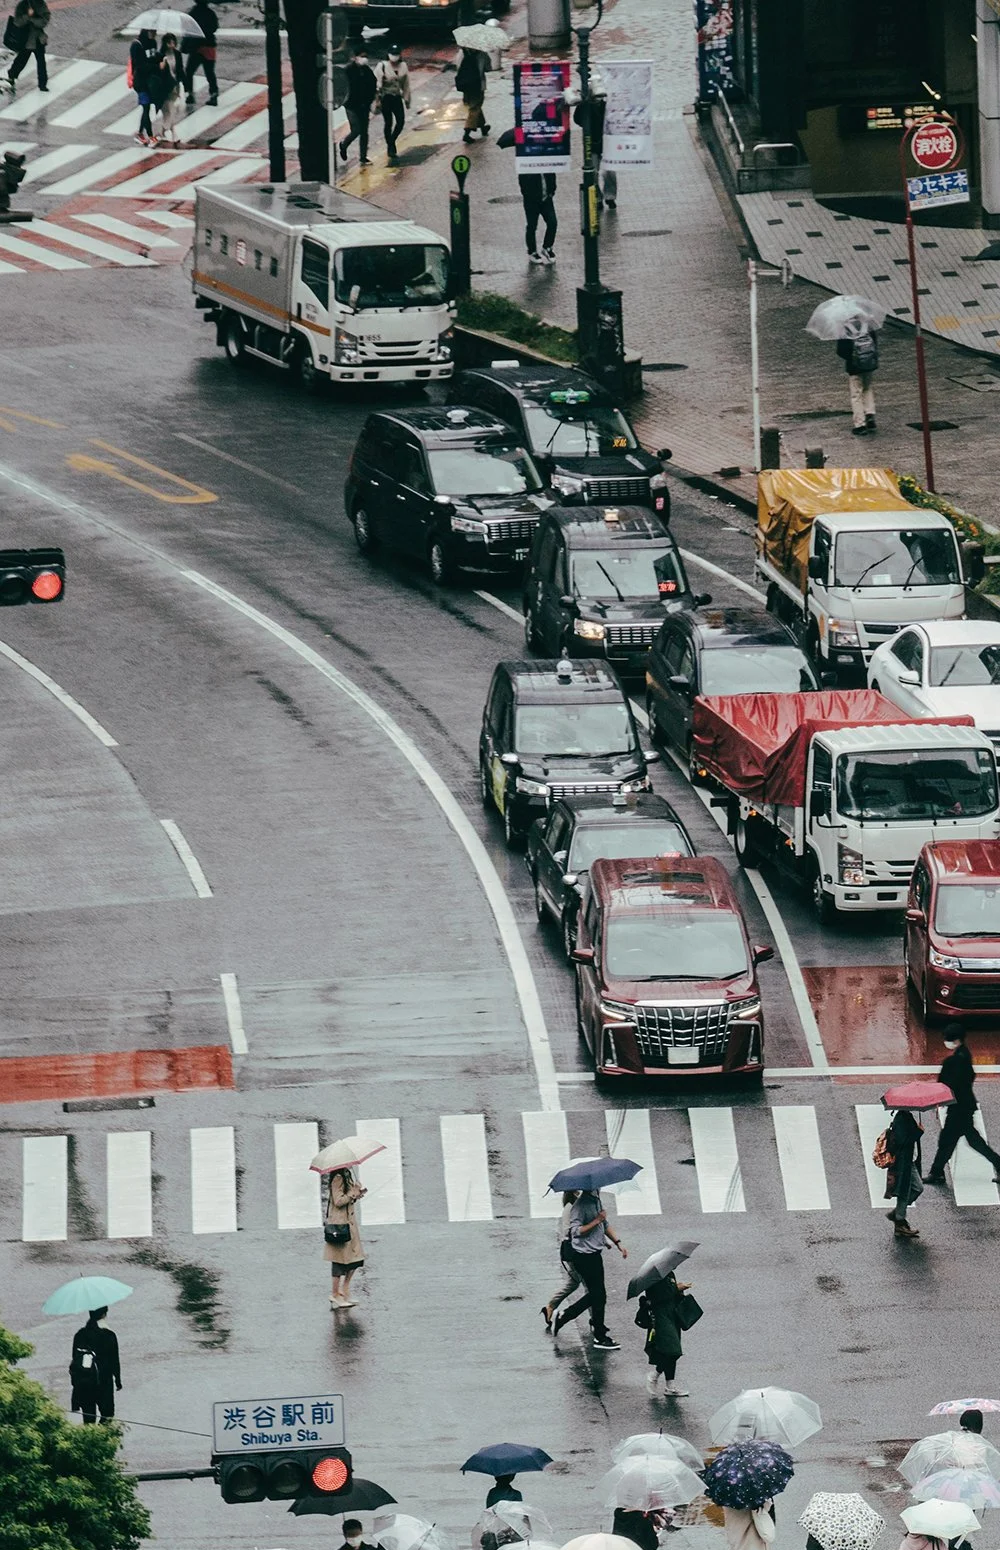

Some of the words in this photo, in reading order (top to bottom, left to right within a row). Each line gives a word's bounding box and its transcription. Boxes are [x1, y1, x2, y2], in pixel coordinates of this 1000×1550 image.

[916, 135, 953, 155] 消火栓
[224, 1402, 334, 1430] 渋谷駅前
[241, 1432, 292, 1446] Shibuya
[297, 1429, 323, 1442] Sta.
